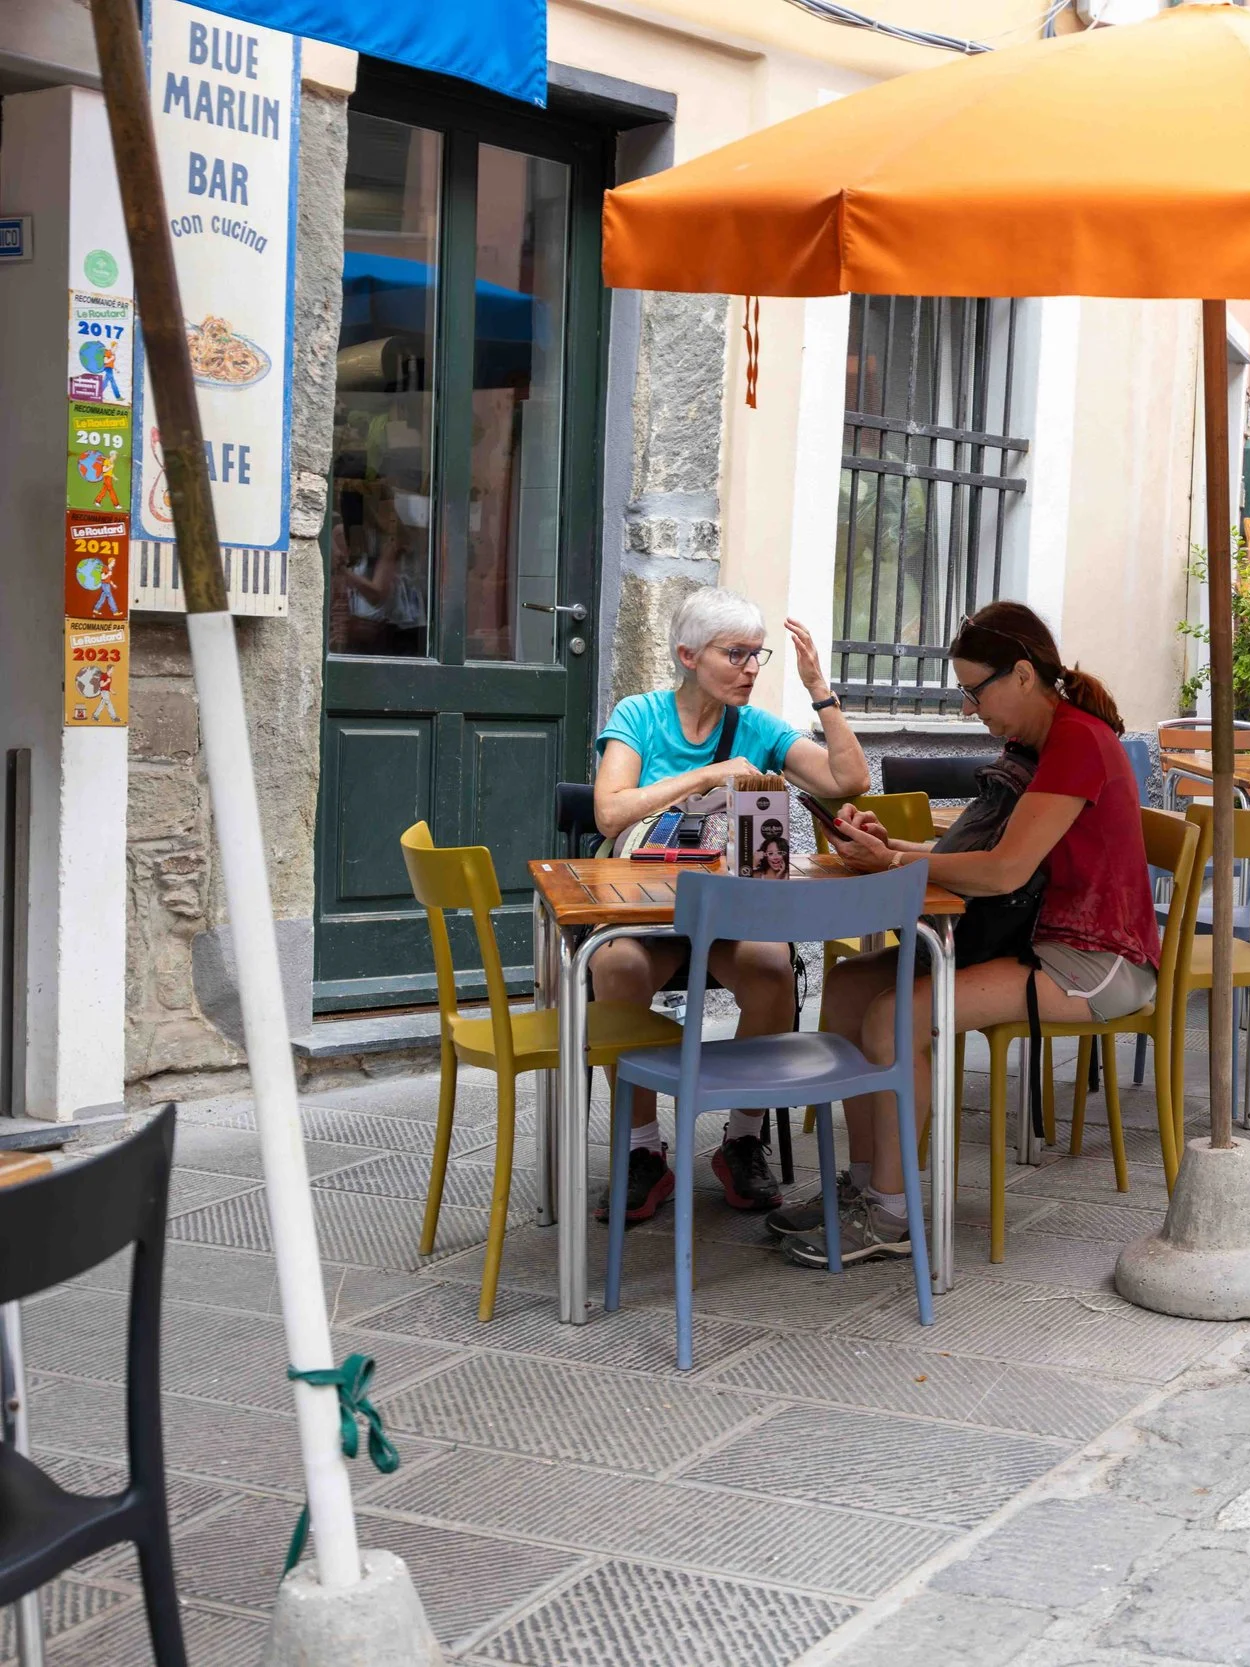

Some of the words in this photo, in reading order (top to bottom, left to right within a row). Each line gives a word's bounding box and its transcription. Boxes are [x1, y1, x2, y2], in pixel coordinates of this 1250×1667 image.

[188, 20, 259, 80] BLUE
[163, 71, 280, 140] MARLIN
[188, 151, 250, 206] BAR
[170, 214, 204, 238] con
[211, 215, 268, 254] cucina
[78, 320, 124, 339] 2017
[76, 430, 123, 449] 2019
[74, 539, 119, 555] 2021
[72, 647, 121, 662] 2023
